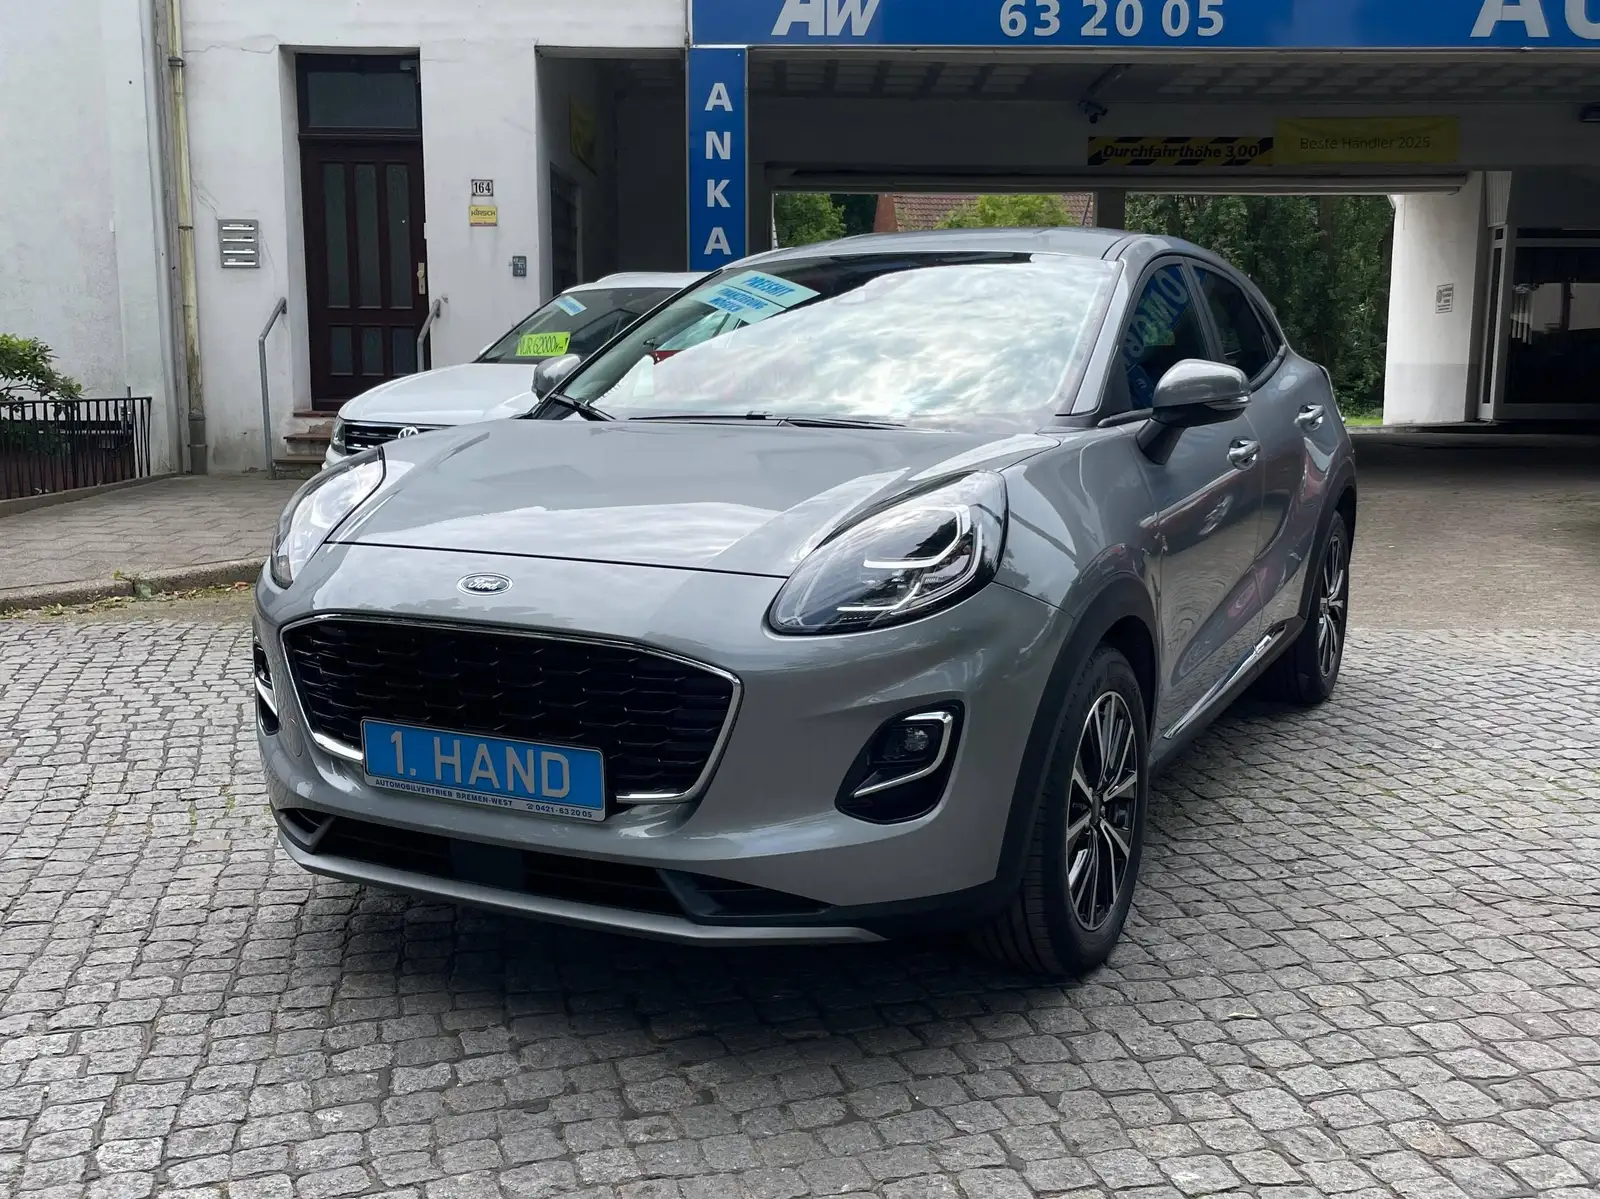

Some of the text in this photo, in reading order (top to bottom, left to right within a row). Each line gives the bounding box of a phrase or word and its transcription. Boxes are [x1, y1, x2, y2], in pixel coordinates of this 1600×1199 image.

[771, 0, 880, 36] AW
[1000, 0, 1224, 37] 63 20 05
[1103, 144, 1221, 158] Durchfahrthöhe
[1300, 136, 1430, 150] Beste Händler 2025
[704, 83, 733, 255] ANKA
[474, 182, 491, 194] 164
[467, 577, 501, 590] Ford
[391, 731, 570, 798] 1. HAND
[375, 779, 452, 798] AUTOMOBILVERTRIEB
